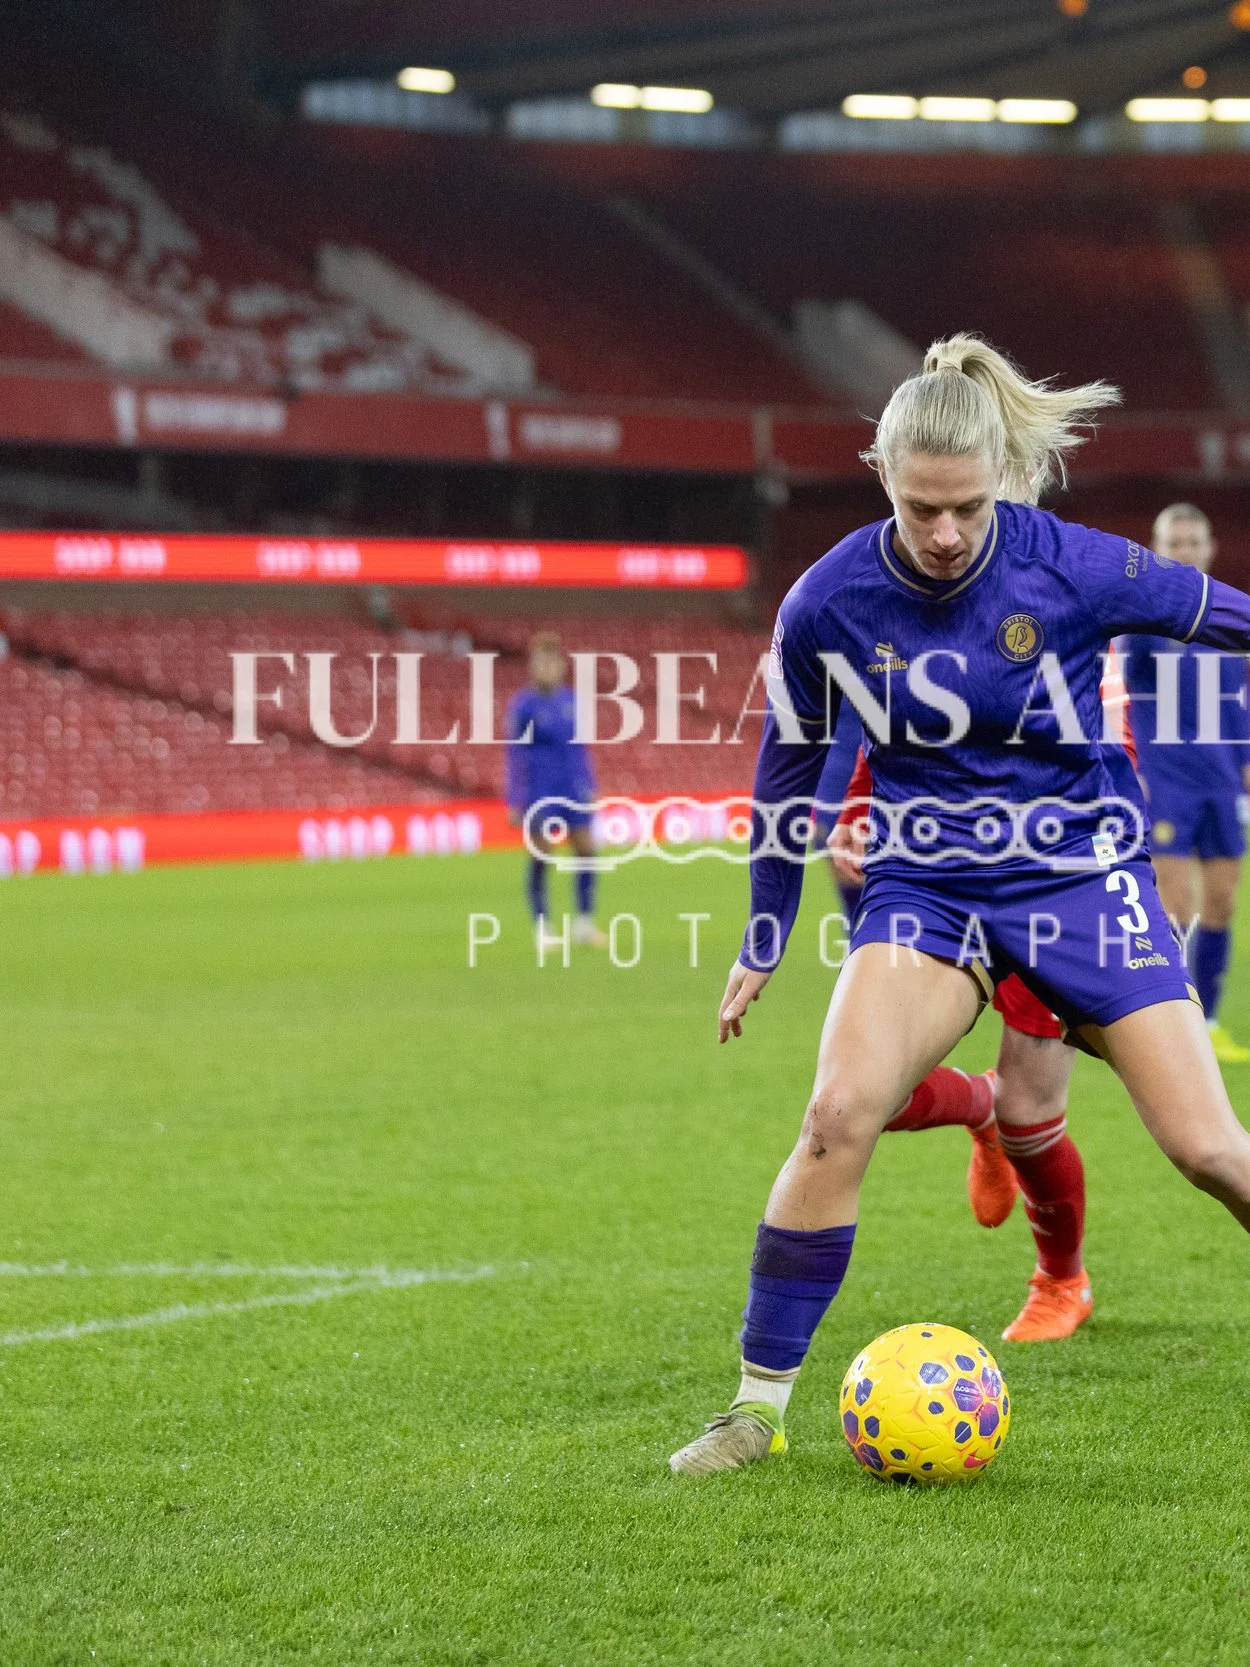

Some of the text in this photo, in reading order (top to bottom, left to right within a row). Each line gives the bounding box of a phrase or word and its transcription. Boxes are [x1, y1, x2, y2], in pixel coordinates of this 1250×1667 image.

[1003, 616, 1033, 630] BRISTOL
[1013, 650, 1033, 659] CITY
[1105, 869, 1150, 934] 3
